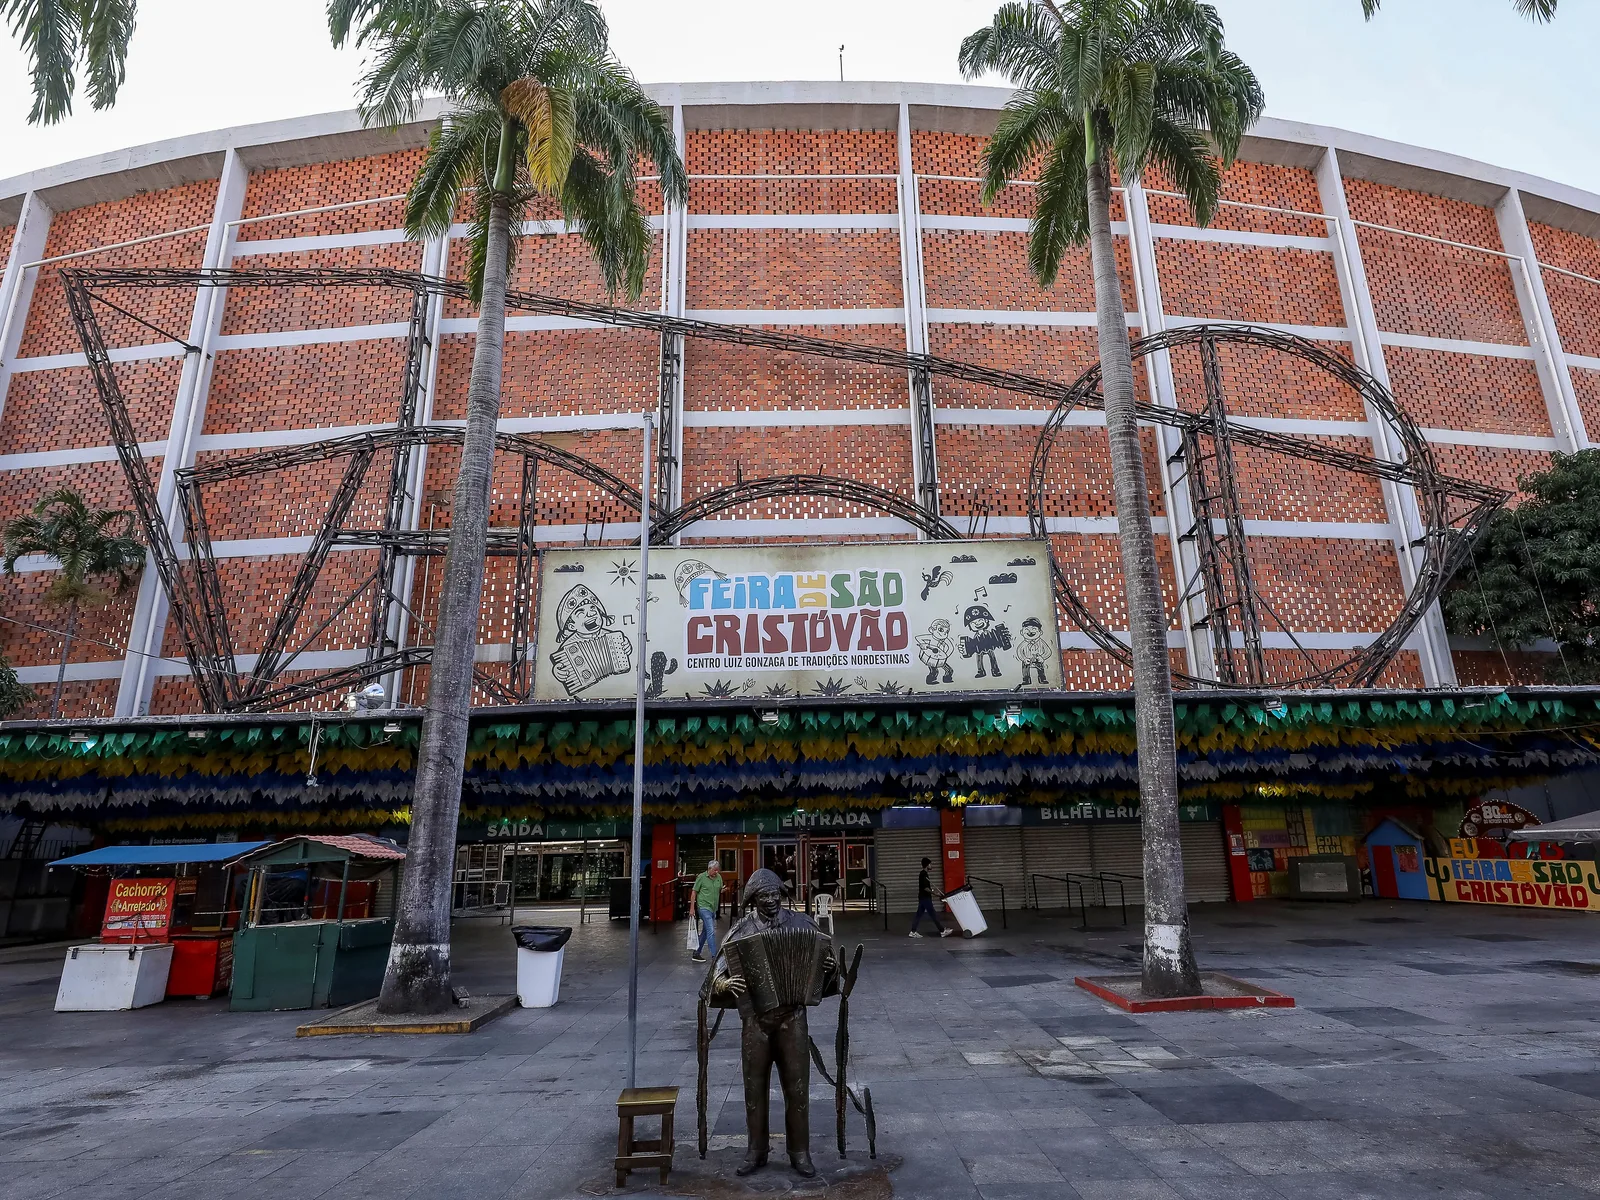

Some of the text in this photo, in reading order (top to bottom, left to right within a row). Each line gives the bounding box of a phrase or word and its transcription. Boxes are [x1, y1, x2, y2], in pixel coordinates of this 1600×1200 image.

[797, 574, 827, 608] DE
[831, 570, 904, 608] SÃO
[687, 609, 909, 656] CRISTÓVÃO
[687, 653, 910, 668] CENTRO LUIZ GONZAGA DE TRADIÇÕES NORDESTINAS
[782, 811, 872, 827] ENTRADA
[1449, 838, 1479, 859] EU
[1509, 861, 1532, 882] DE
[1532, 861, 1583, 884] SÃO
[115, 882, 168, 897] Cachorrão
[1455, 881, 1589, 908] CRISTÓVÃO
[120, 900, 156, 912] Arretado
